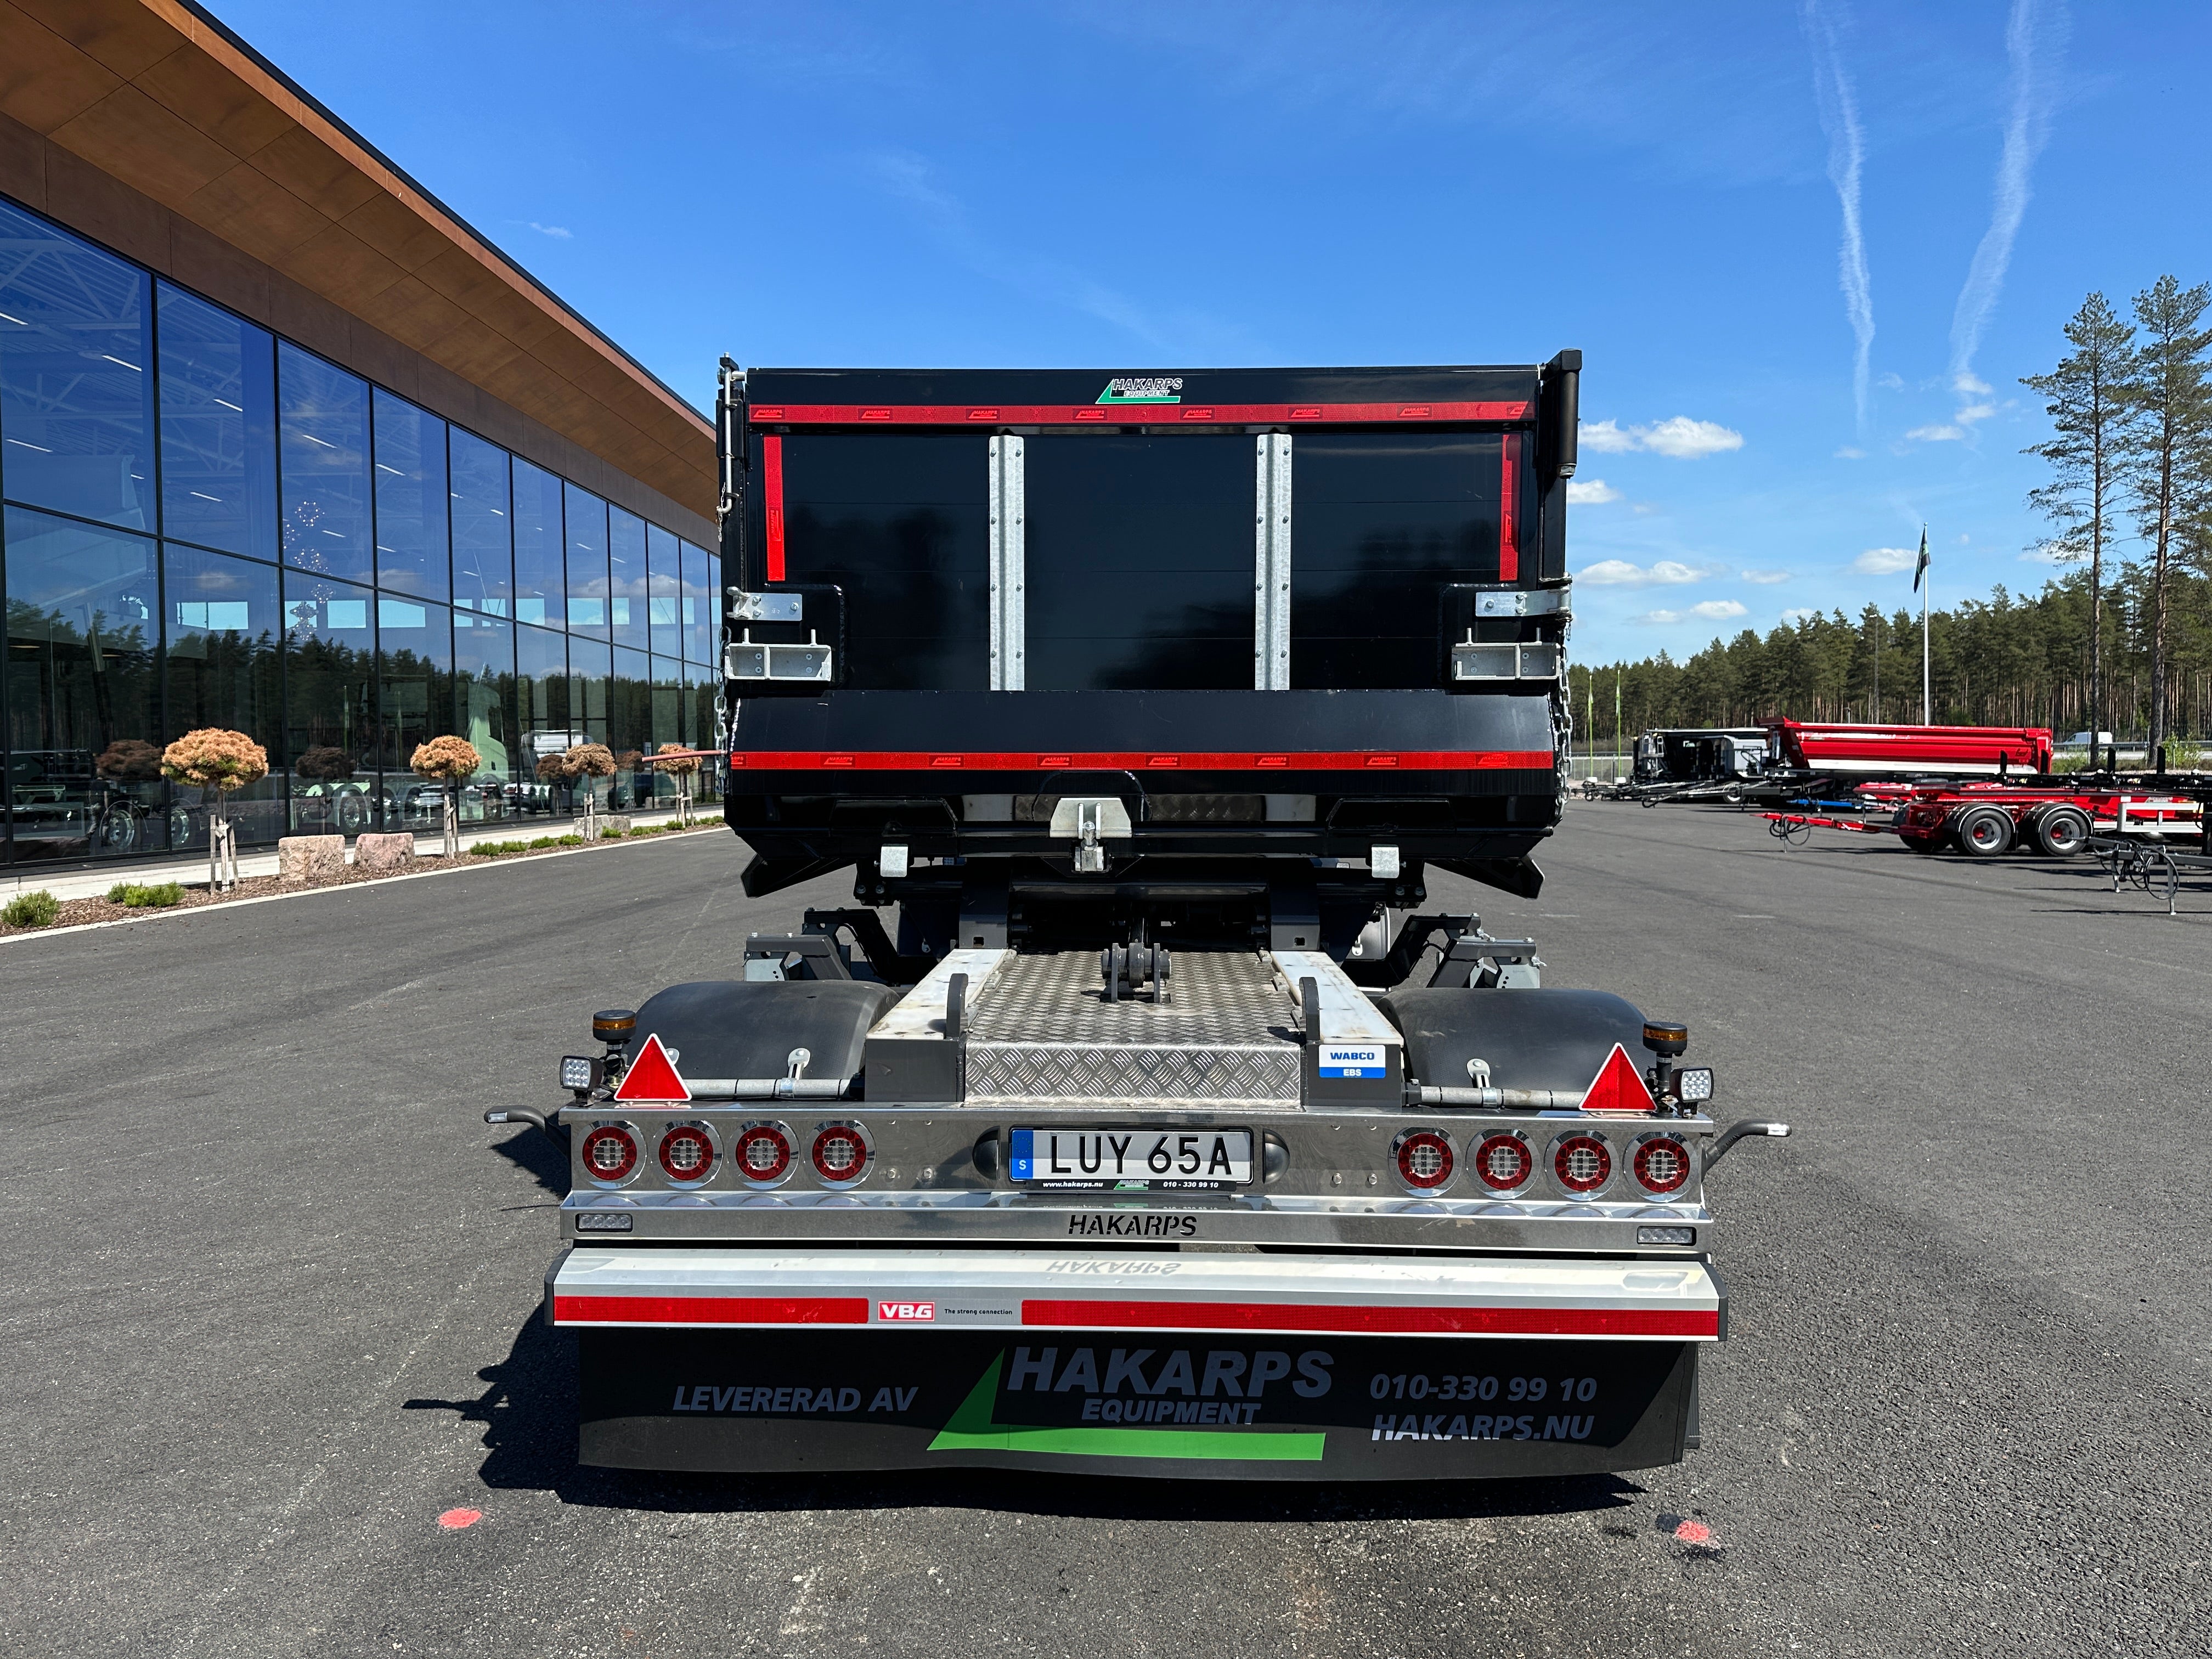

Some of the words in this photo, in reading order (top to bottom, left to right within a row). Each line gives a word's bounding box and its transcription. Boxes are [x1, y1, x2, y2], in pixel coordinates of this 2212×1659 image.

[1113, 377, 1183, 390] HAKARPS
[1343, 1068, 1362, 1076] EBS
[1019, 1159, 1027, 1170] S
[1051, 1135, 1132, 1174] LUY
[1148, 1136, 1233, 1175] 65A
[1068, 1214, 1198, 1237] HAKARPS
[881, 1304, 933, 1318] VBG
[1007, 1346, 1335, 1398] HAKARPS
[673, 1386, 861, 1412] LEVERERAD
[868, 1386, 919, 1412] AV
[1370, 1373, 1499, 1401] 010-330
[1507, 1376, 1547, 1402] 99
[1560, 1377, 1598, 1402] 10
[1081, 1398, 1261, 1425] EQUIPMENT
[1370, 1414, 1595, 1441] HAKARPS.NU
